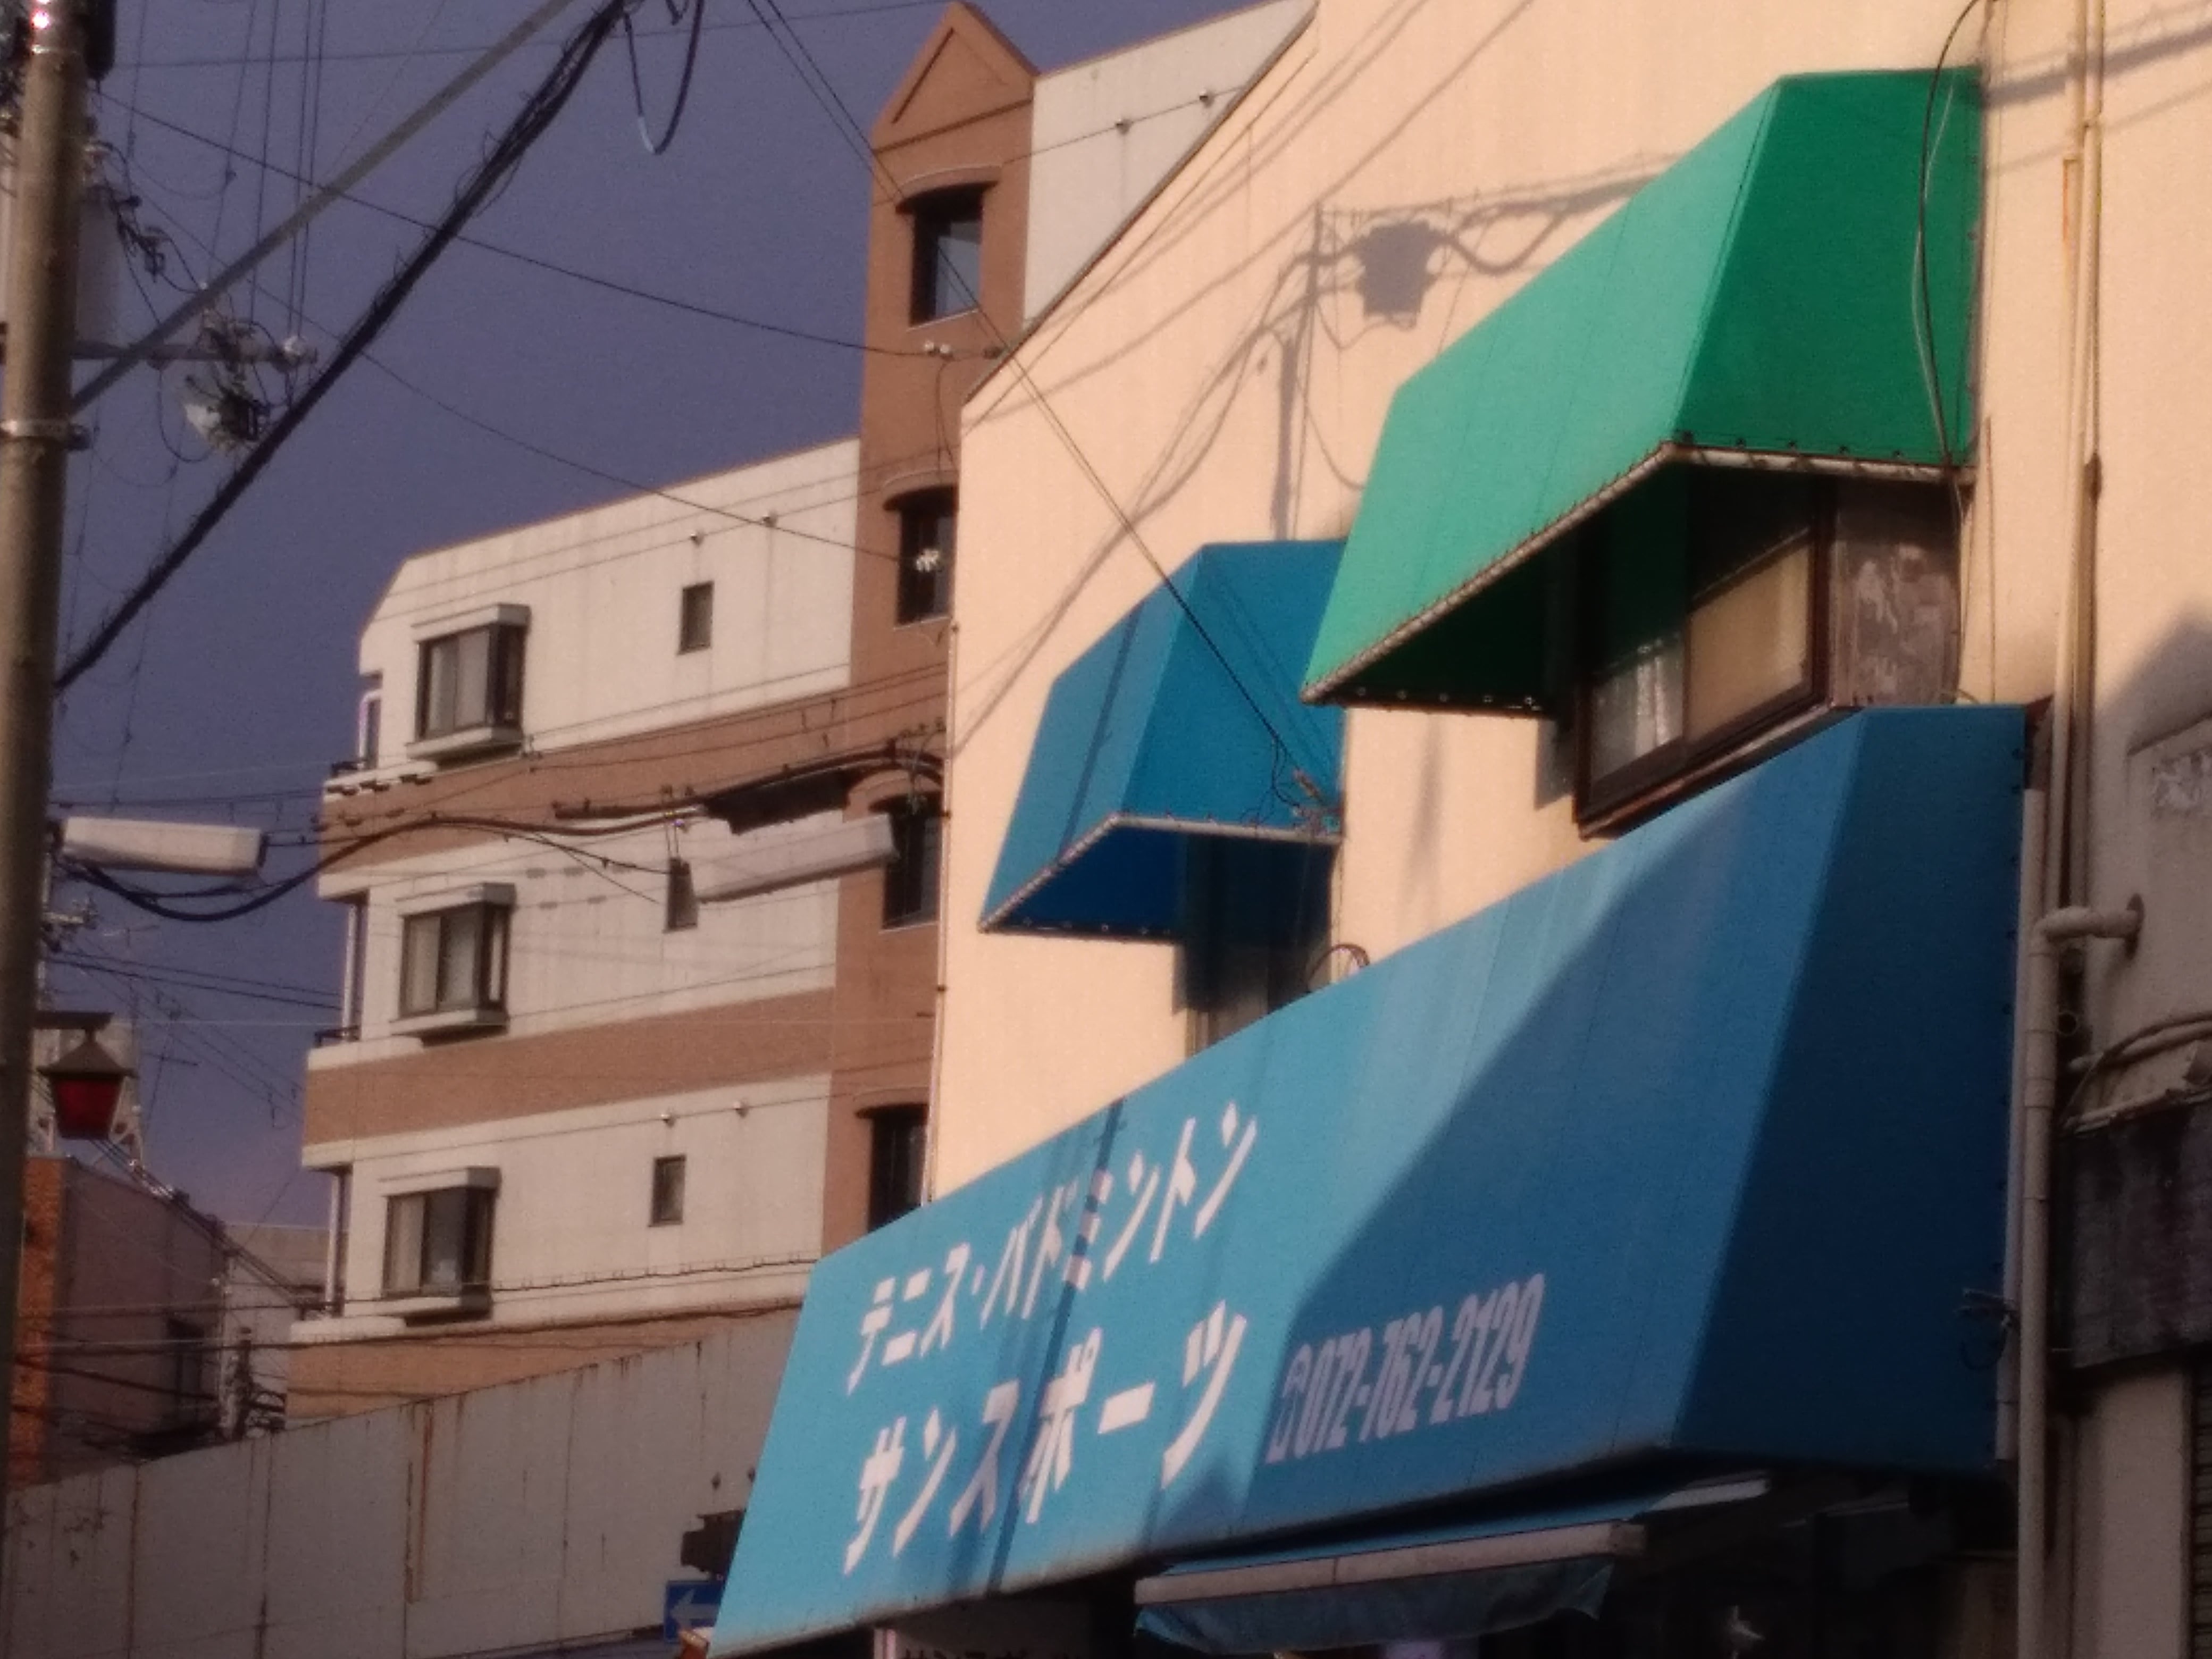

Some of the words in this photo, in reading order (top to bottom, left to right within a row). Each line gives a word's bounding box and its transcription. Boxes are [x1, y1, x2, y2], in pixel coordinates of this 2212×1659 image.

[844, 1300, 1247, 1575] サンスポーツ
